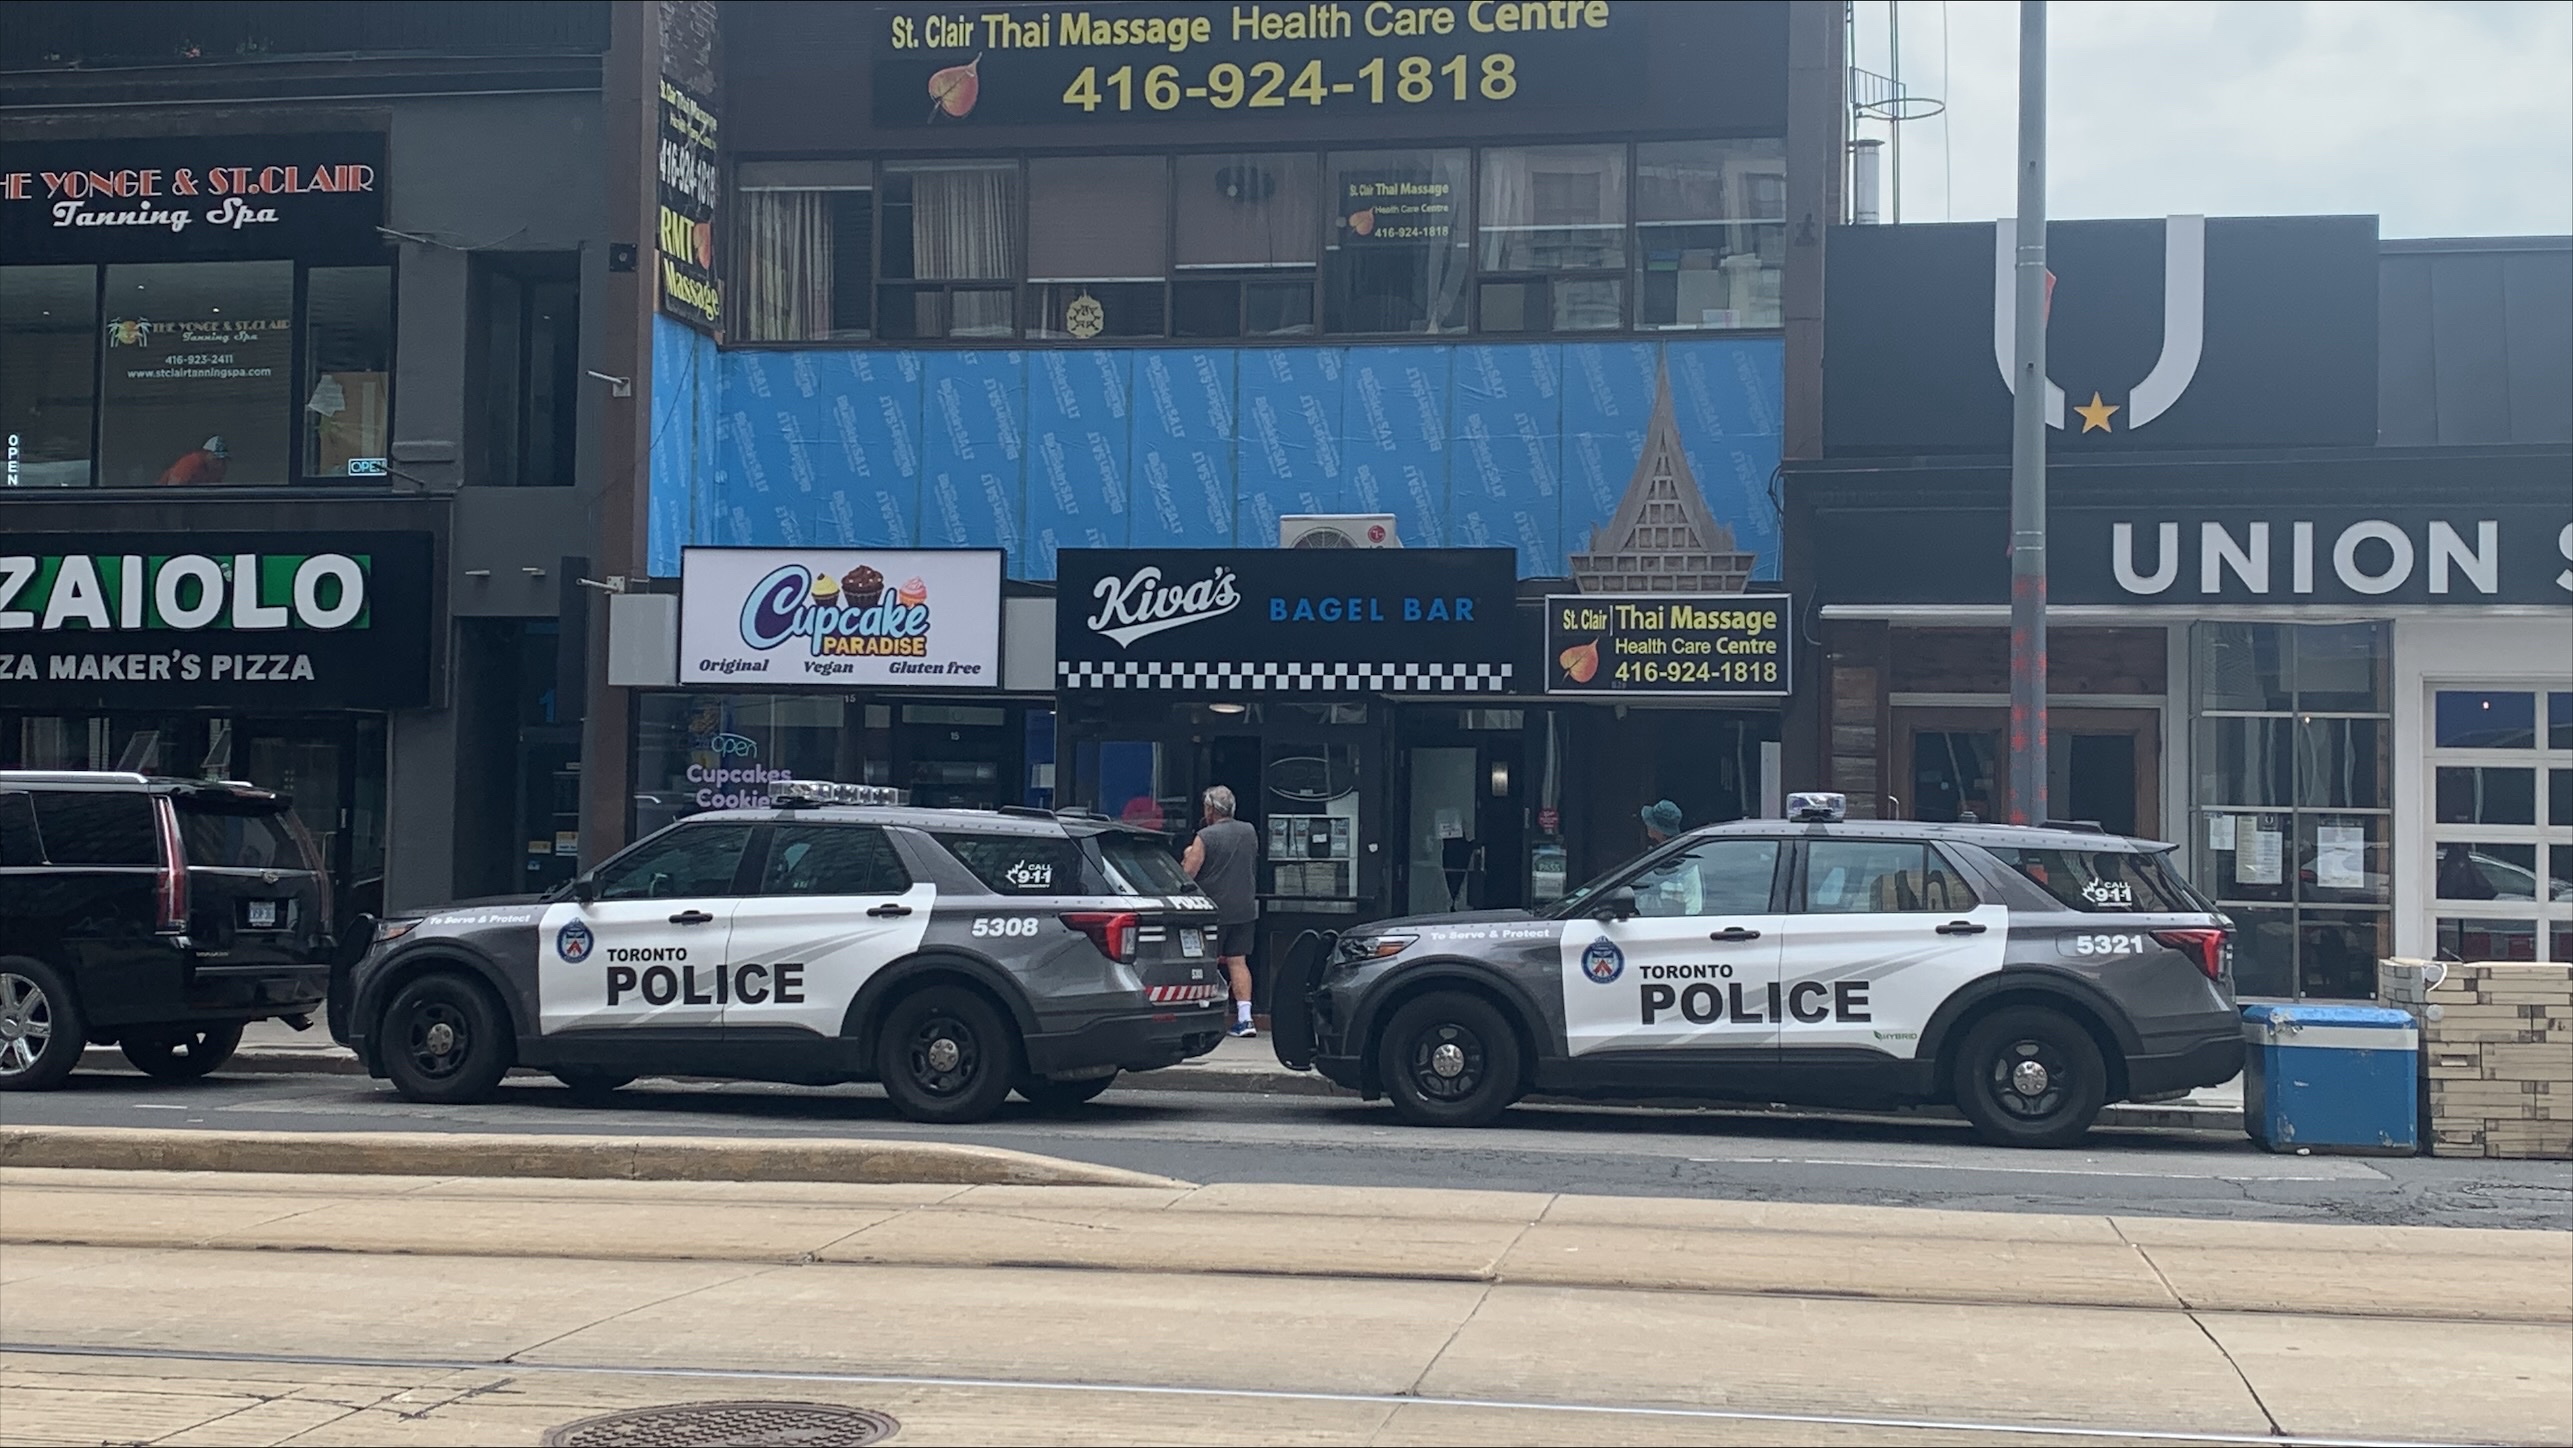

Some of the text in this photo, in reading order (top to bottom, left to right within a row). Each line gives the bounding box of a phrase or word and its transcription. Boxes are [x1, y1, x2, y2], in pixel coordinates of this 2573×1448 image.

[892, 0, 1610, 52] St. Clair Thai Massage Health Care Centre
[1063, 53, 1517, 112] 416-924-1818
[40, 169, 162, 199] YONGE
[172, 168, 199, 196] &
[208, 164, 374, 195] ST.CLAIR
[1375, 183, 1398, 196] Thai
[1400, 183, 1449, 197] Massage
[52, 197, 279, 233] Tanning Spa
[660, 205, 695, 265] RMT
[1375, 226, 1449, 238] 416-924-1818
[663, 257, 721, 322] Massage
[182, 331, 258, 344] Tanning Spa
[165, 354, 234, 365] 416-923-2411
[127, 367, 272, 379] www.stclairtanningspa.com
[7, 434, 19, 486] OPEN
[351, 461, 386, 473] OPEN
[2113, 519, 2499, 595] UNION
[0, 554, 365, 630] ZAIOLO
[740, 564, 930, 655] Cupcake
[1088, 566, 1241, 642] Kiva's
[1270, 598, 1475, 621] BAGEL BAR
[1563, 605, 1777, 635] St. Clair Thai Massage
[822, 635, 926, 656] PARADISE
[1615, 637, 1777, 655] Health Care Centre
[49, 650, 201, 680] MAKER'S
[211, 655, 315, 680] PIZZA
[699, 659, 981, 675] Original Vegan Gluten free
[1615, 660, 1777, 683] 416-924-1818
[686, 763, 792, 788] Cupcakes
[696, 788, 771, 808] Cookie
[489, 914, 530, 924] Protect
[971, 917, 1039, 938] 5308
[1431, 928, 1550, 940] To Serve & Protect
[2077, 934, 2144, 954] 5321
[607, 947, 687, 962] TORONTO
[1639, 963, 1733, 979] TORONTO
[606, 963, 806, 1007] POLICE
[1639, 980, 1873, 1026] POLICE
